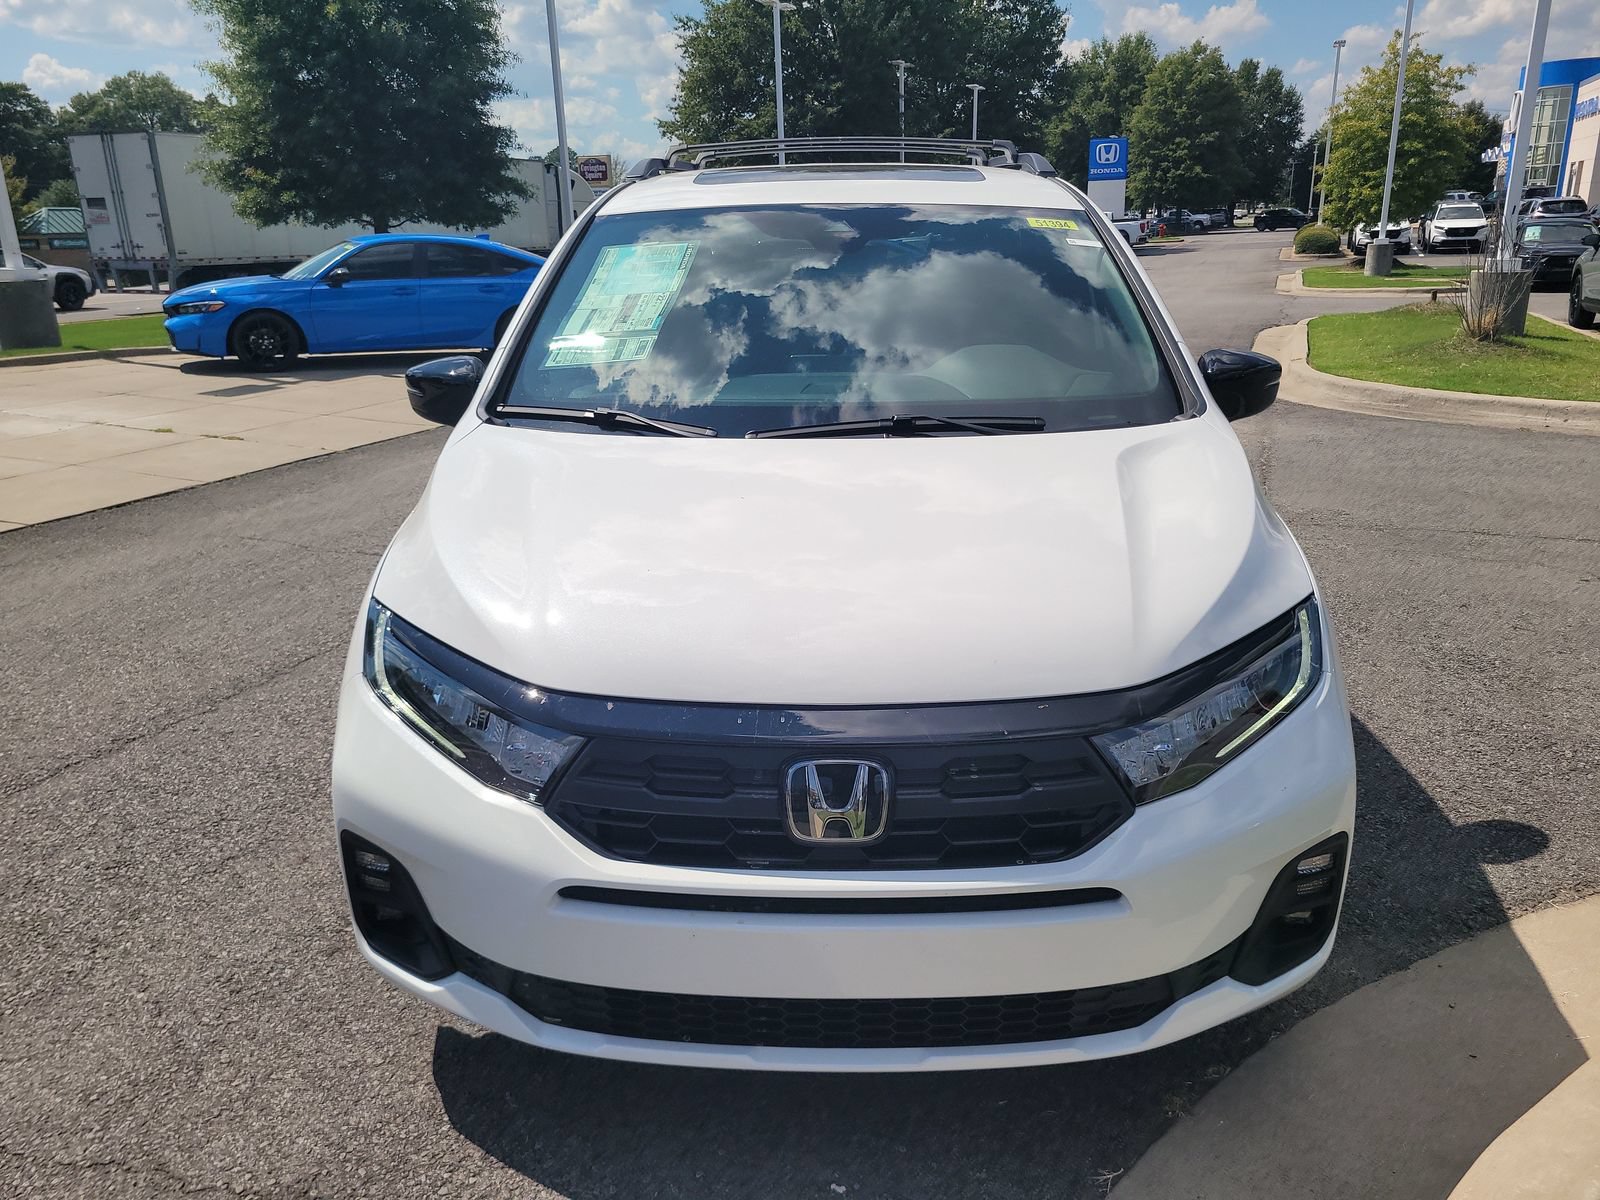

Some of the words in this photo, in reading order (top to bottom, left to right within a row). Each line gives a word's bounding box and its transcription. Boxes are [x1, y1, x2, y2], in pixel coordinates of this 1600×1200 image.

[1090, 167, 1124, 175] HONDA
[584, 172, 603, 180] Square
[1034, 219, 1071, 229] 51394
